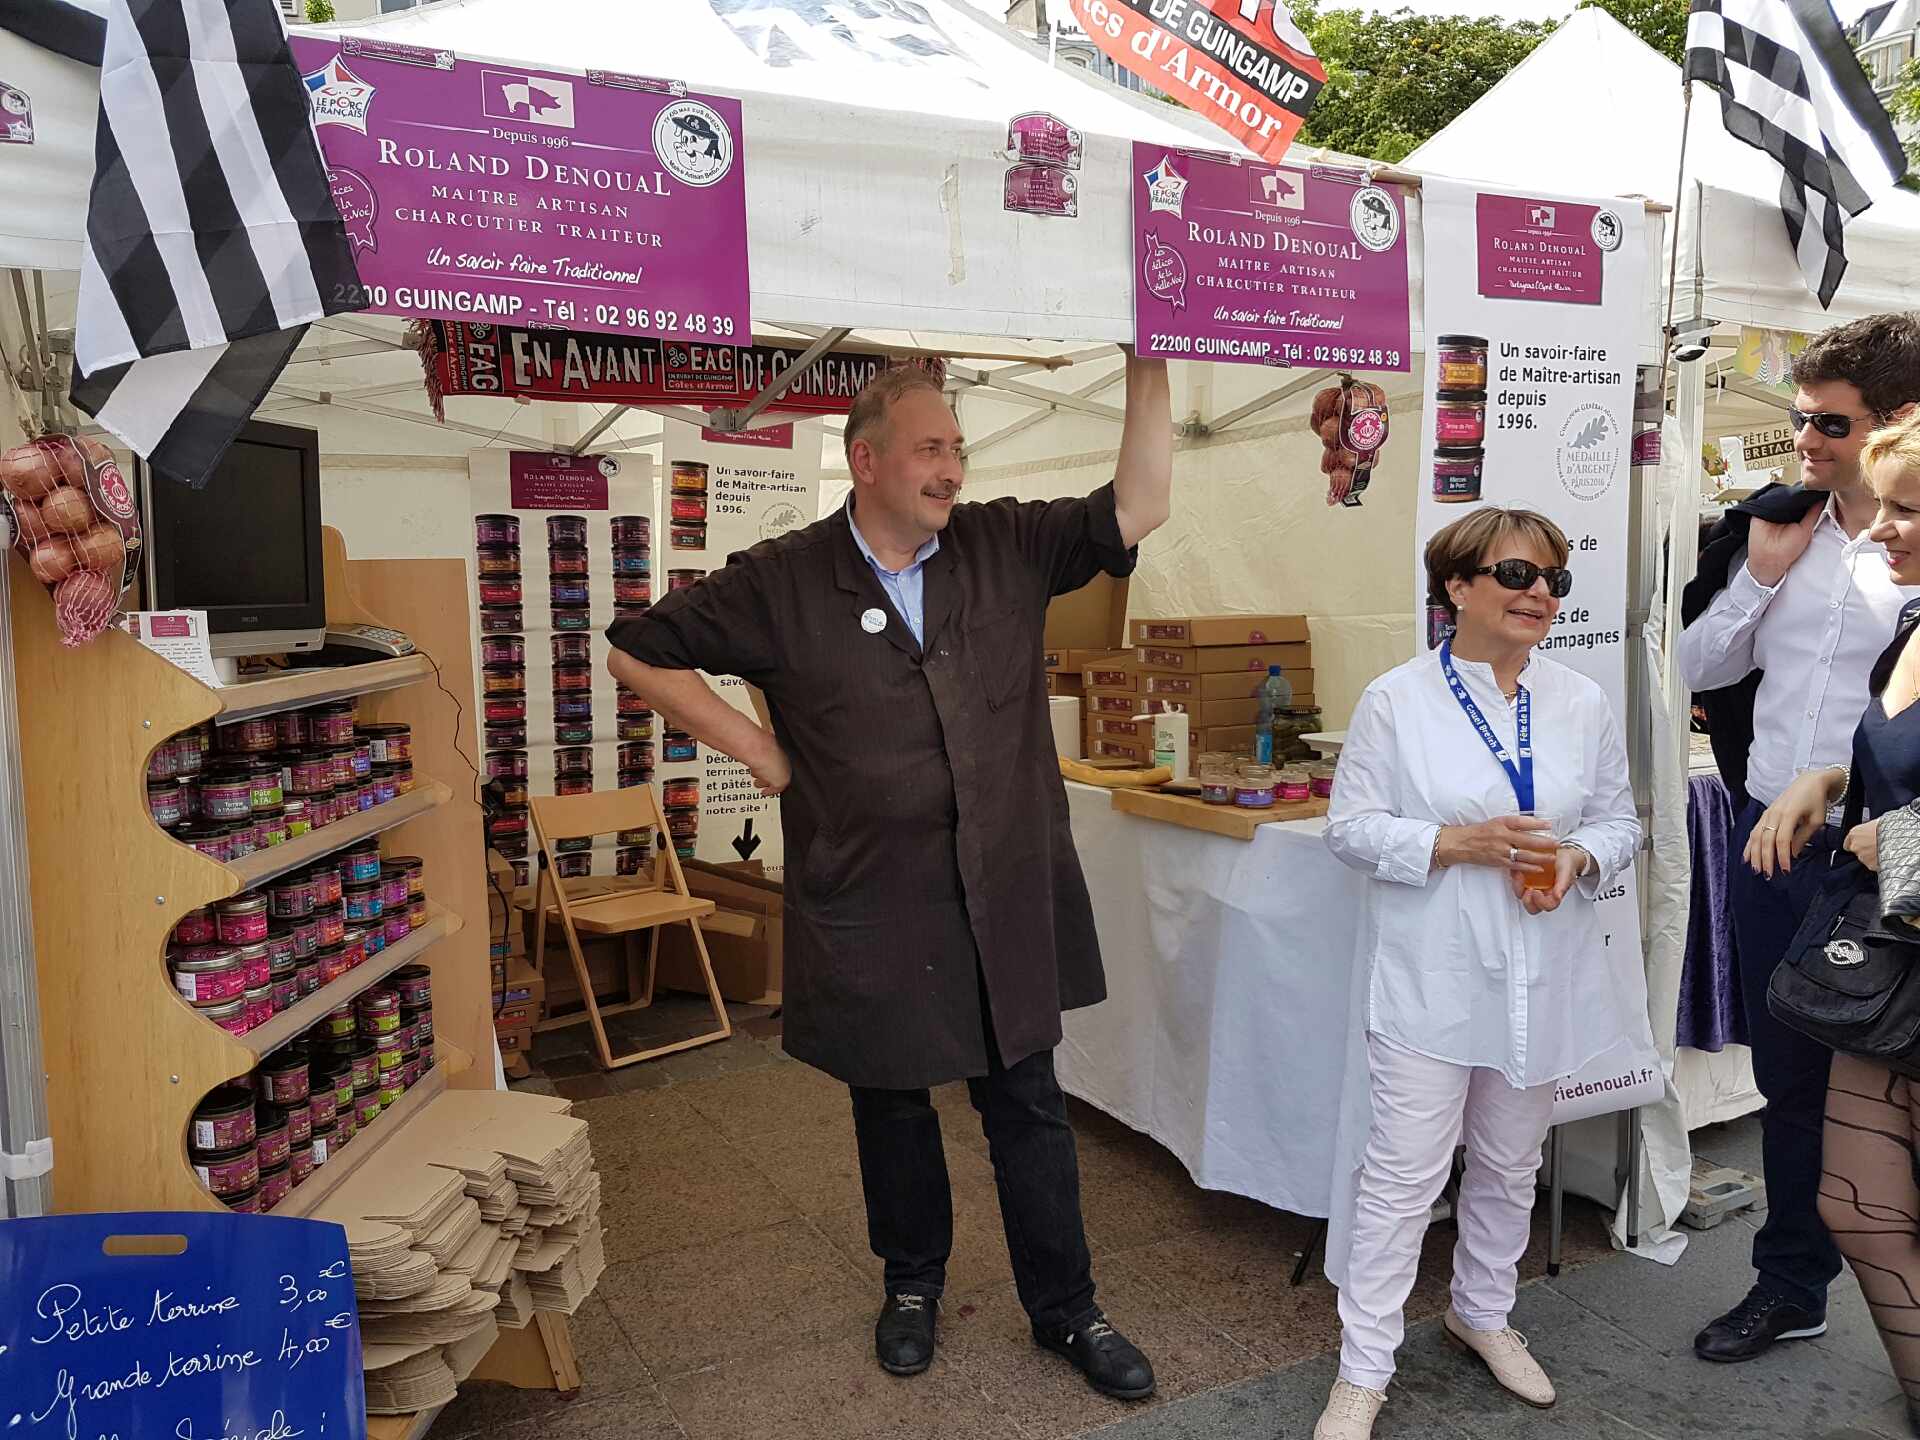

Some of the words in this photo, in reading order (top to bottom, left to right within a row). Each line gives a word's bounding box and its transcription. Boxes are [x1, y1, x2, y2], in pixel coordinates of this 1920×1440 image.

[1150, 0, 1188, 30] DE
[1186, 10, 1310, 105] GUINGAMP
[1130, 28, 1282, 138] d'Armor
[316, 106, 362, 117] FRANÇAIS
[317, 97, 327, 106] LE
[330, 97, 362, 110] PORC
[492, 127, 538, 145] Depuis
[542, 135, 569, 148] 1996
[377, 137, 510, 177] ROLAND
[525, 154, 671, 196] DENOUAL
[431, 185, 518, 206] MAITRE
[536, 195, 629, 219] ARTISAN
[395, 207, 544, 234] CHARCUTIER
[557, 223, 663, 248] TRAITEUR
[1255, 209, 1282, 223] Depuis
[1284, 215, 1301, 227] 1996
[1187, 221, 1266, 250] ROLAND
[1273, 231, 1363, 261] DENOUAL
[1494, 237, 1535, 250] ROLAND
[1539, 241, 1587, 256] DENOUAL
[425, 246, 451, 267] Un
[454, 251, 505, 273] savoir
[508, 253, 549, 276] faire
[553, 256, 643, 285] Traditionnel
[1218, 256, 1271, 272] MAITRE
[1280, 264, 1336, 279] ARTISAN
[1509, 255, 1537, 264] MAITRE
[1497, 265, 1545, 275] CHARCUTIER
[1548, 269, 1582, 278] TRAITEUR
[1196, 274, 1285, 293] CHARCUTIER
[1292, 284, 1357, 300] TRAITEUR
[395, 286, 522, 316] GUINGAMP
[543, 298, 576, 321] Tél
[595, 303, 620, 325] 02
[626, 306, 649, 329] 96
[655, 308, 678, 332] 92
[684, 312, 707, 334] 48
[711, 315, 735, 337] 39
[1213, 305, 1229, 321] Un
[1230, 307, 1260, 324] savoir
[1263, 309, 1286, 326] faire
[1289, 310, 1344, 330] Traditionnel
[690, 346, 732, 371] EAG
[1150, 334, 1191, 352] 22200
[1194, 337, 1271, 357] GUINGAMP
[1282, 344, 1302, 359] Tél
[1313, 347, 1328, 362] 02
[1332, 348, 1347, 363] 96
[1350, 350, 1365, 364] 92
[1368, 350, 1383, 366] 48
[1386, 351, 1400, 367] 39
[1500, 342, 1519, 358] Un
[1524, 344, 1607, 361] savoir-faire
[468, 342, 500, 391] EAG
[510, 331, 552, 386] EN
[561, 337, 656, 391] AVANT
[742, 351, 765, 392] DE
[1499, 365, 1517, 381] de
[1522, 366, 1621, 384] Maître-artisan
[1497, 389, 1547, 409] depuis
[1497, 412, 1538, 429] 1996.
[1743, 431, 1769, 447] FÊTE
[1773, 428, 1789, 440] DE
[1744, 441, 1793, 460] BRETAG
[523, 472, 556, 481] ROLAND
[559, 474, 595, 482] DENOUAL
[716, 466, 731, 475] Un
[734, 469, 796, 480] savoir-faire
[715, 479, 730, 489] de
[715, 492, 751, 503] depuis
[715, 505, 746, 515] 1996.
[1579, 534, 1598, 551] de
[1570, 607, 1590, 623] de
[1537, 629, 1620, 651] campagnes
[706, 767, 751, 777] terrines
[706, 781, 718, 791] et
[721, 778, 752, 791] pâtés
[706, 806, 736, 815] notre
[740, 803, 761, 813] site
[1553, 1067, 1654, 1103] riedenoual.fr
[31, 1283, 135, 1345] Petite
[147, 1285, 240, 1327] terrine
[31, 1367, 153, 1440] Grande
[155, 1343, 262, 1388] terrine
